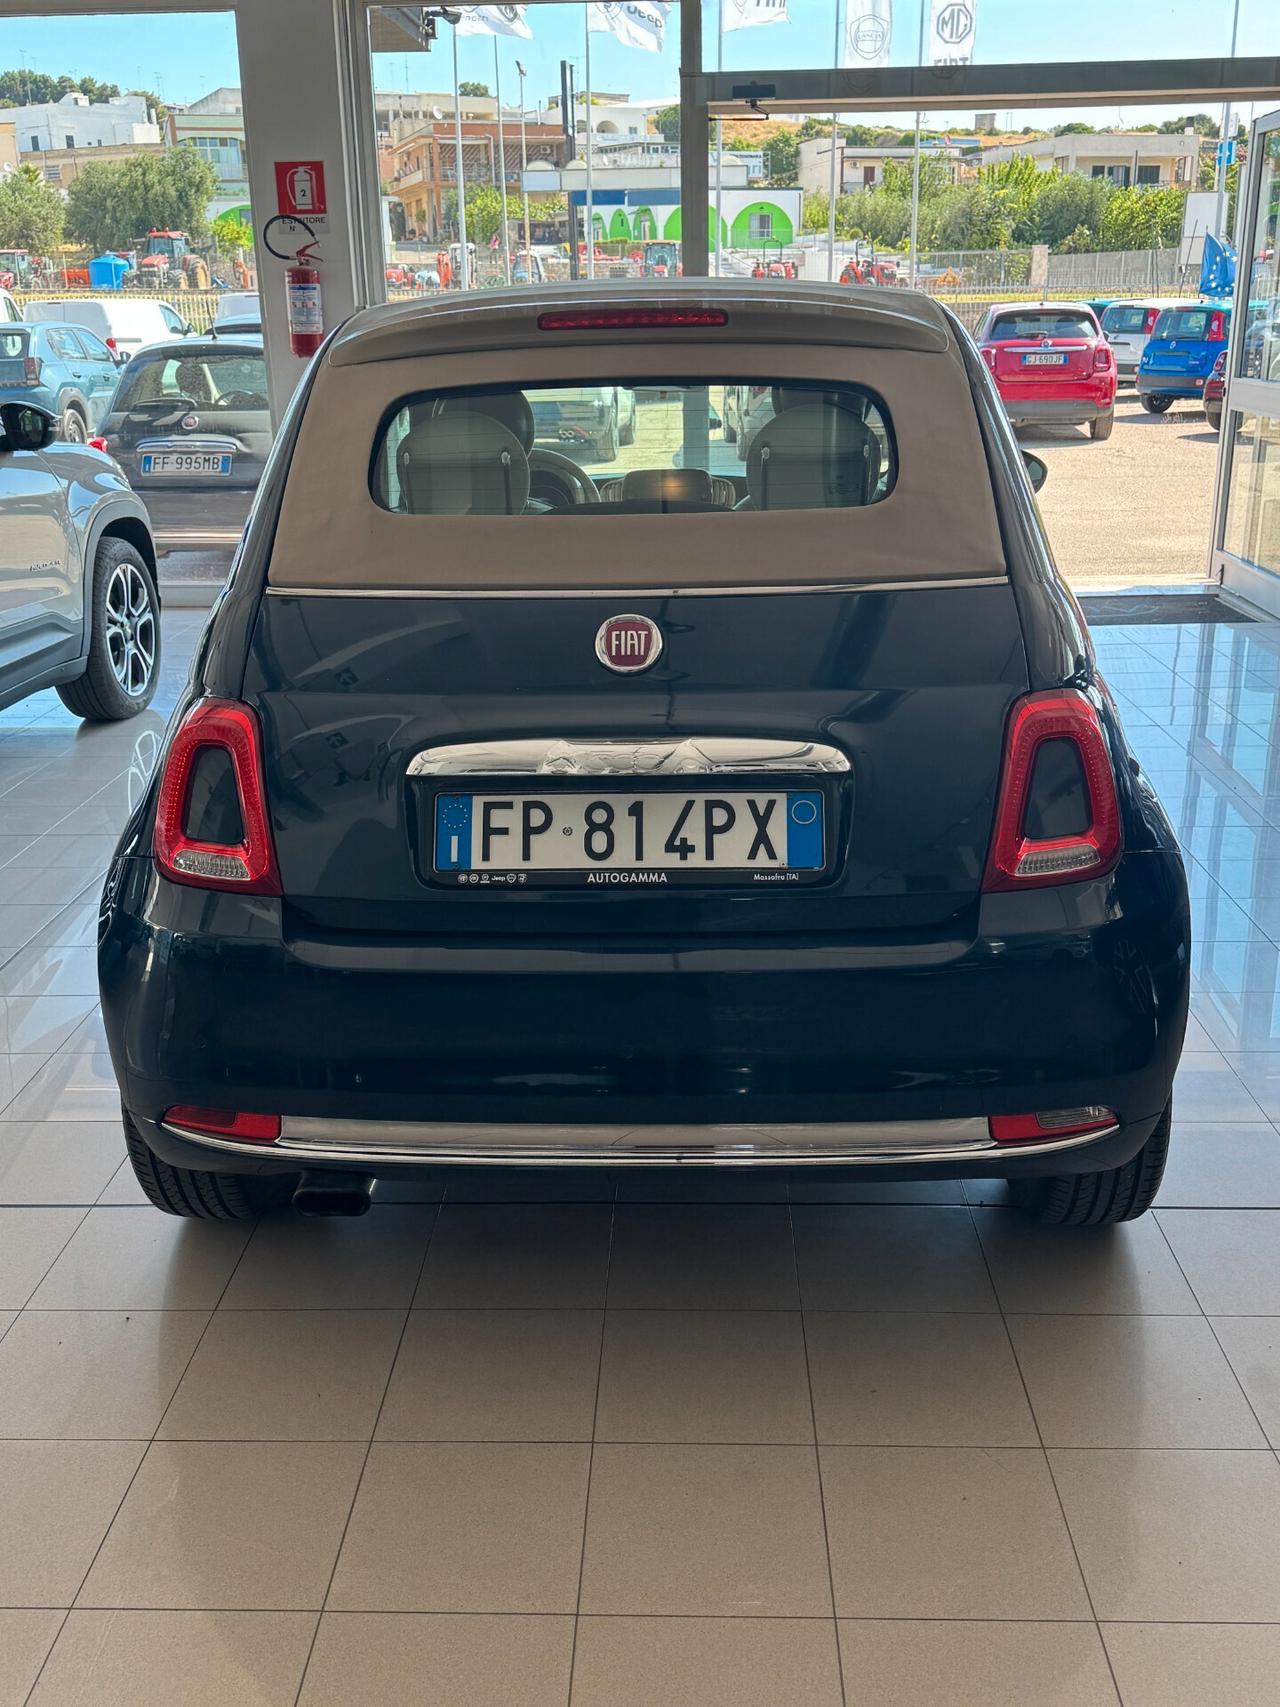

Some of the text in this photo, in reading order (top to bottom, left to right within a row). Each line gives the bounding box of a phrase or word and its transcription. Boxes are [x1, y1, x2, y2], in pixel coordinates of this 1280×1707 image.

[941, 8, 969, 39] MG
[300, 189, 308, 197] 2
[153, 456, 220, 470] FF 995MB
[611, 630, 649, 656] FIAT
[482, 799, 778, 862] FP 814PX
[587, 872, 668, 884] AUTOGAMMA
